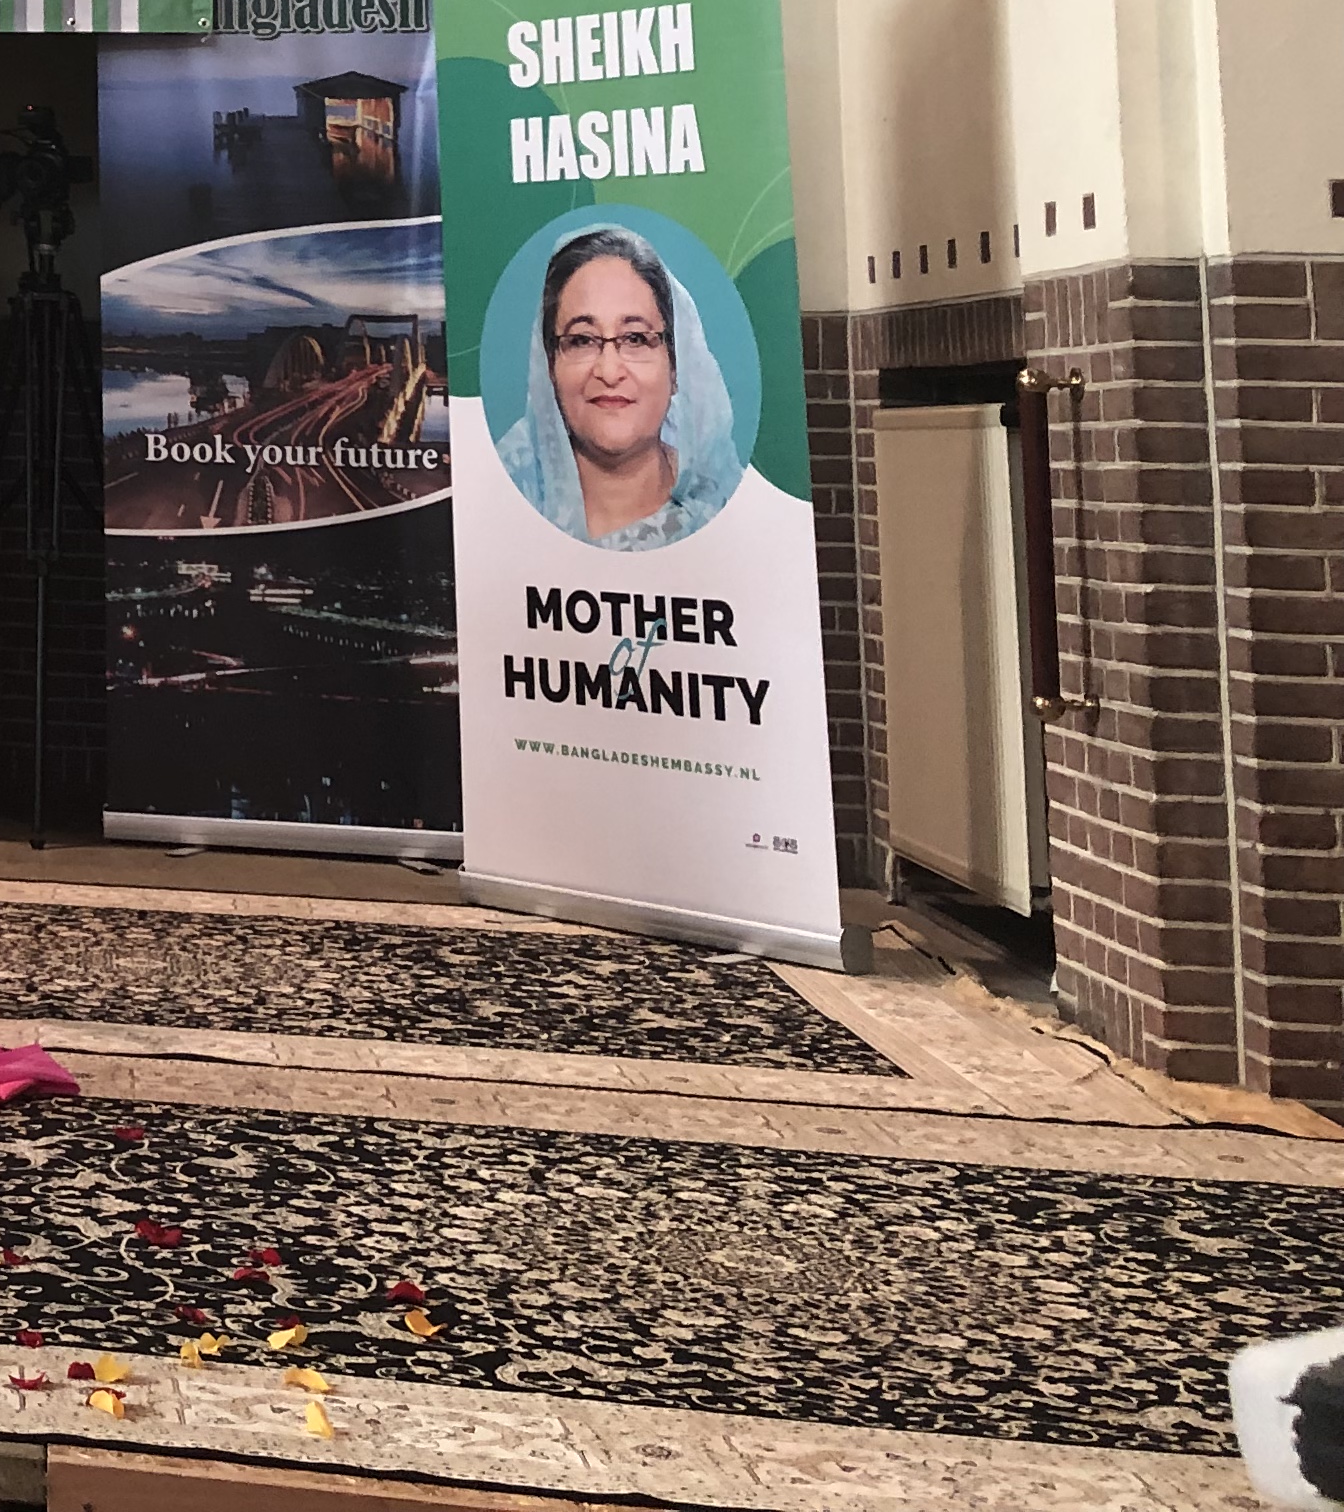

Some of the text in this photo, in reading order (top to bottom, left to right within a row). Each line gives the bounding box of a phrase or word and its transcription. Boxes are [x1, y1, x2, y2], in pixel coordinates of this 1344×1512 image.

[507, 3, 695, 88] SHEIKH
[510, 103, 706, 183] HASINA
[144, 433, 439, 473] Book your future
[525, 585, 738, 647] MOTHER
[503, 654, 770, 726] HUMANITY
[514, 738, 761, 781] WWW.BANGLADESHEMBASSY.NL
